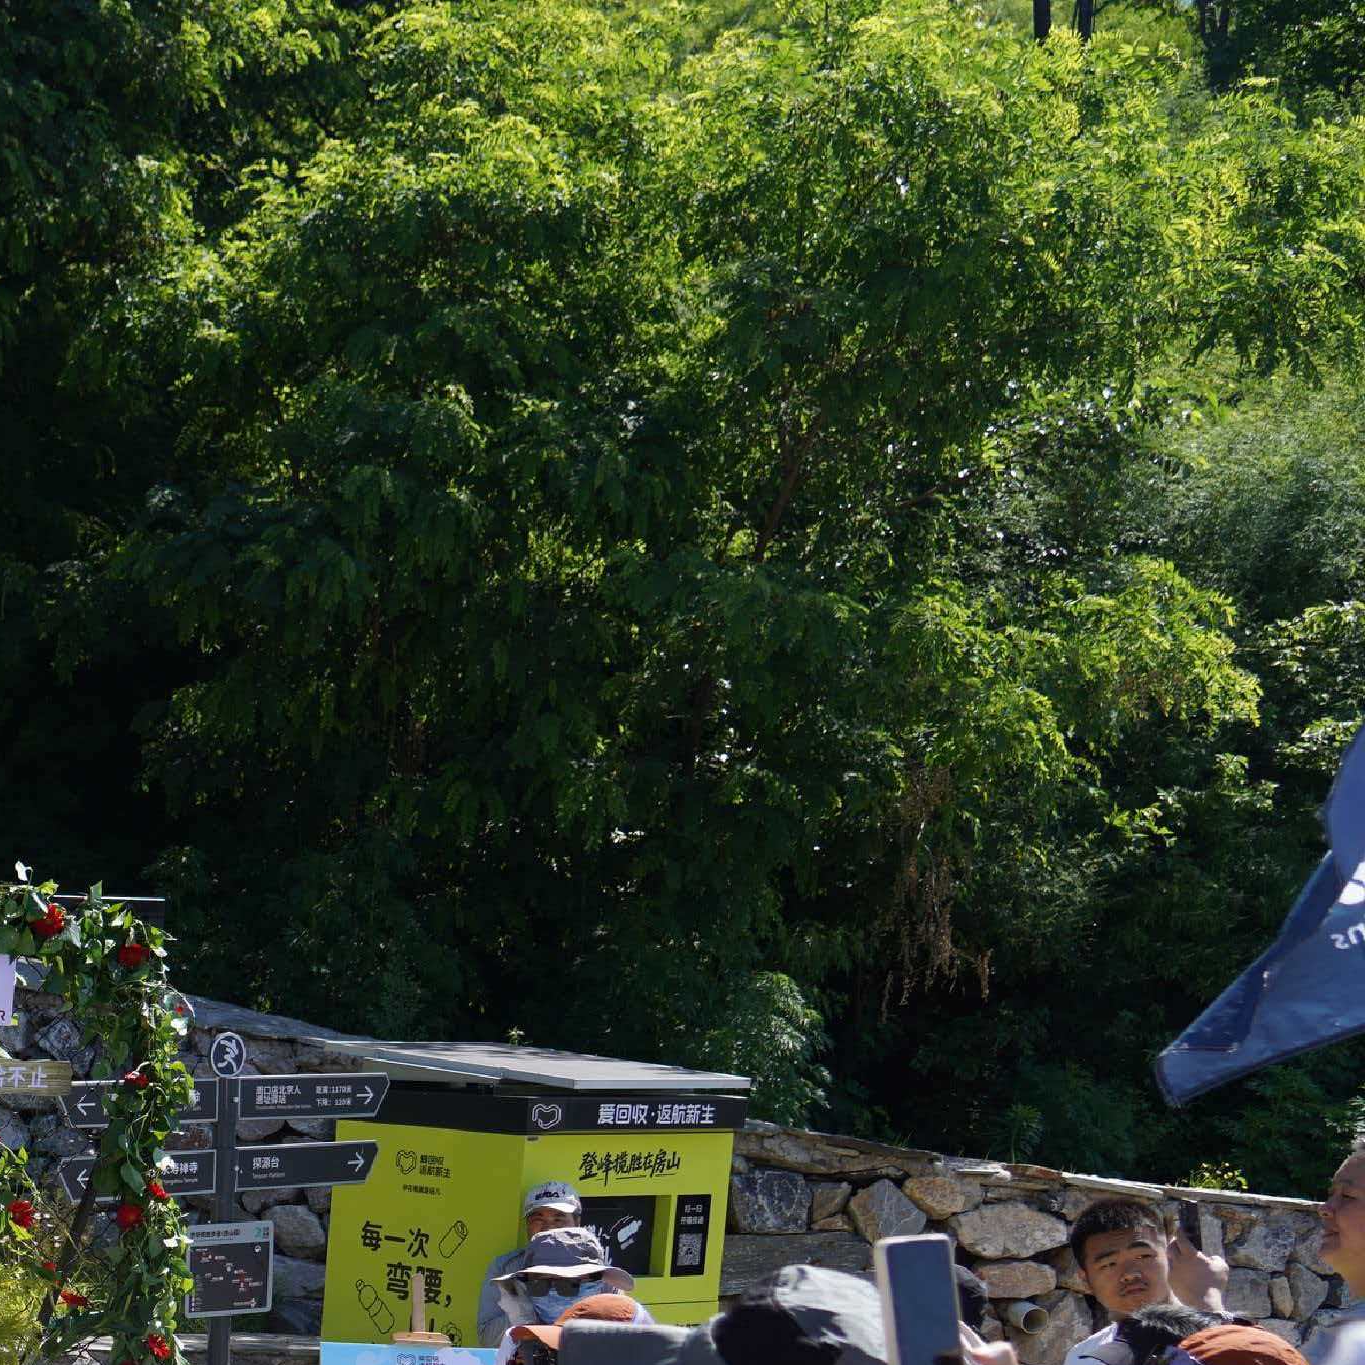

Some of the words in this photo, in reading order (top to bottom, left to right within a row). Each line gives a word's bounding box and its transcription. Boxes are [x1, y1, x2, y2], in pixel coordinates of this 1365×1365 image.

[597, 1103, 717, 1126] 爱回收·返航新生
[361, 1221, 430, 1258] 每一次
